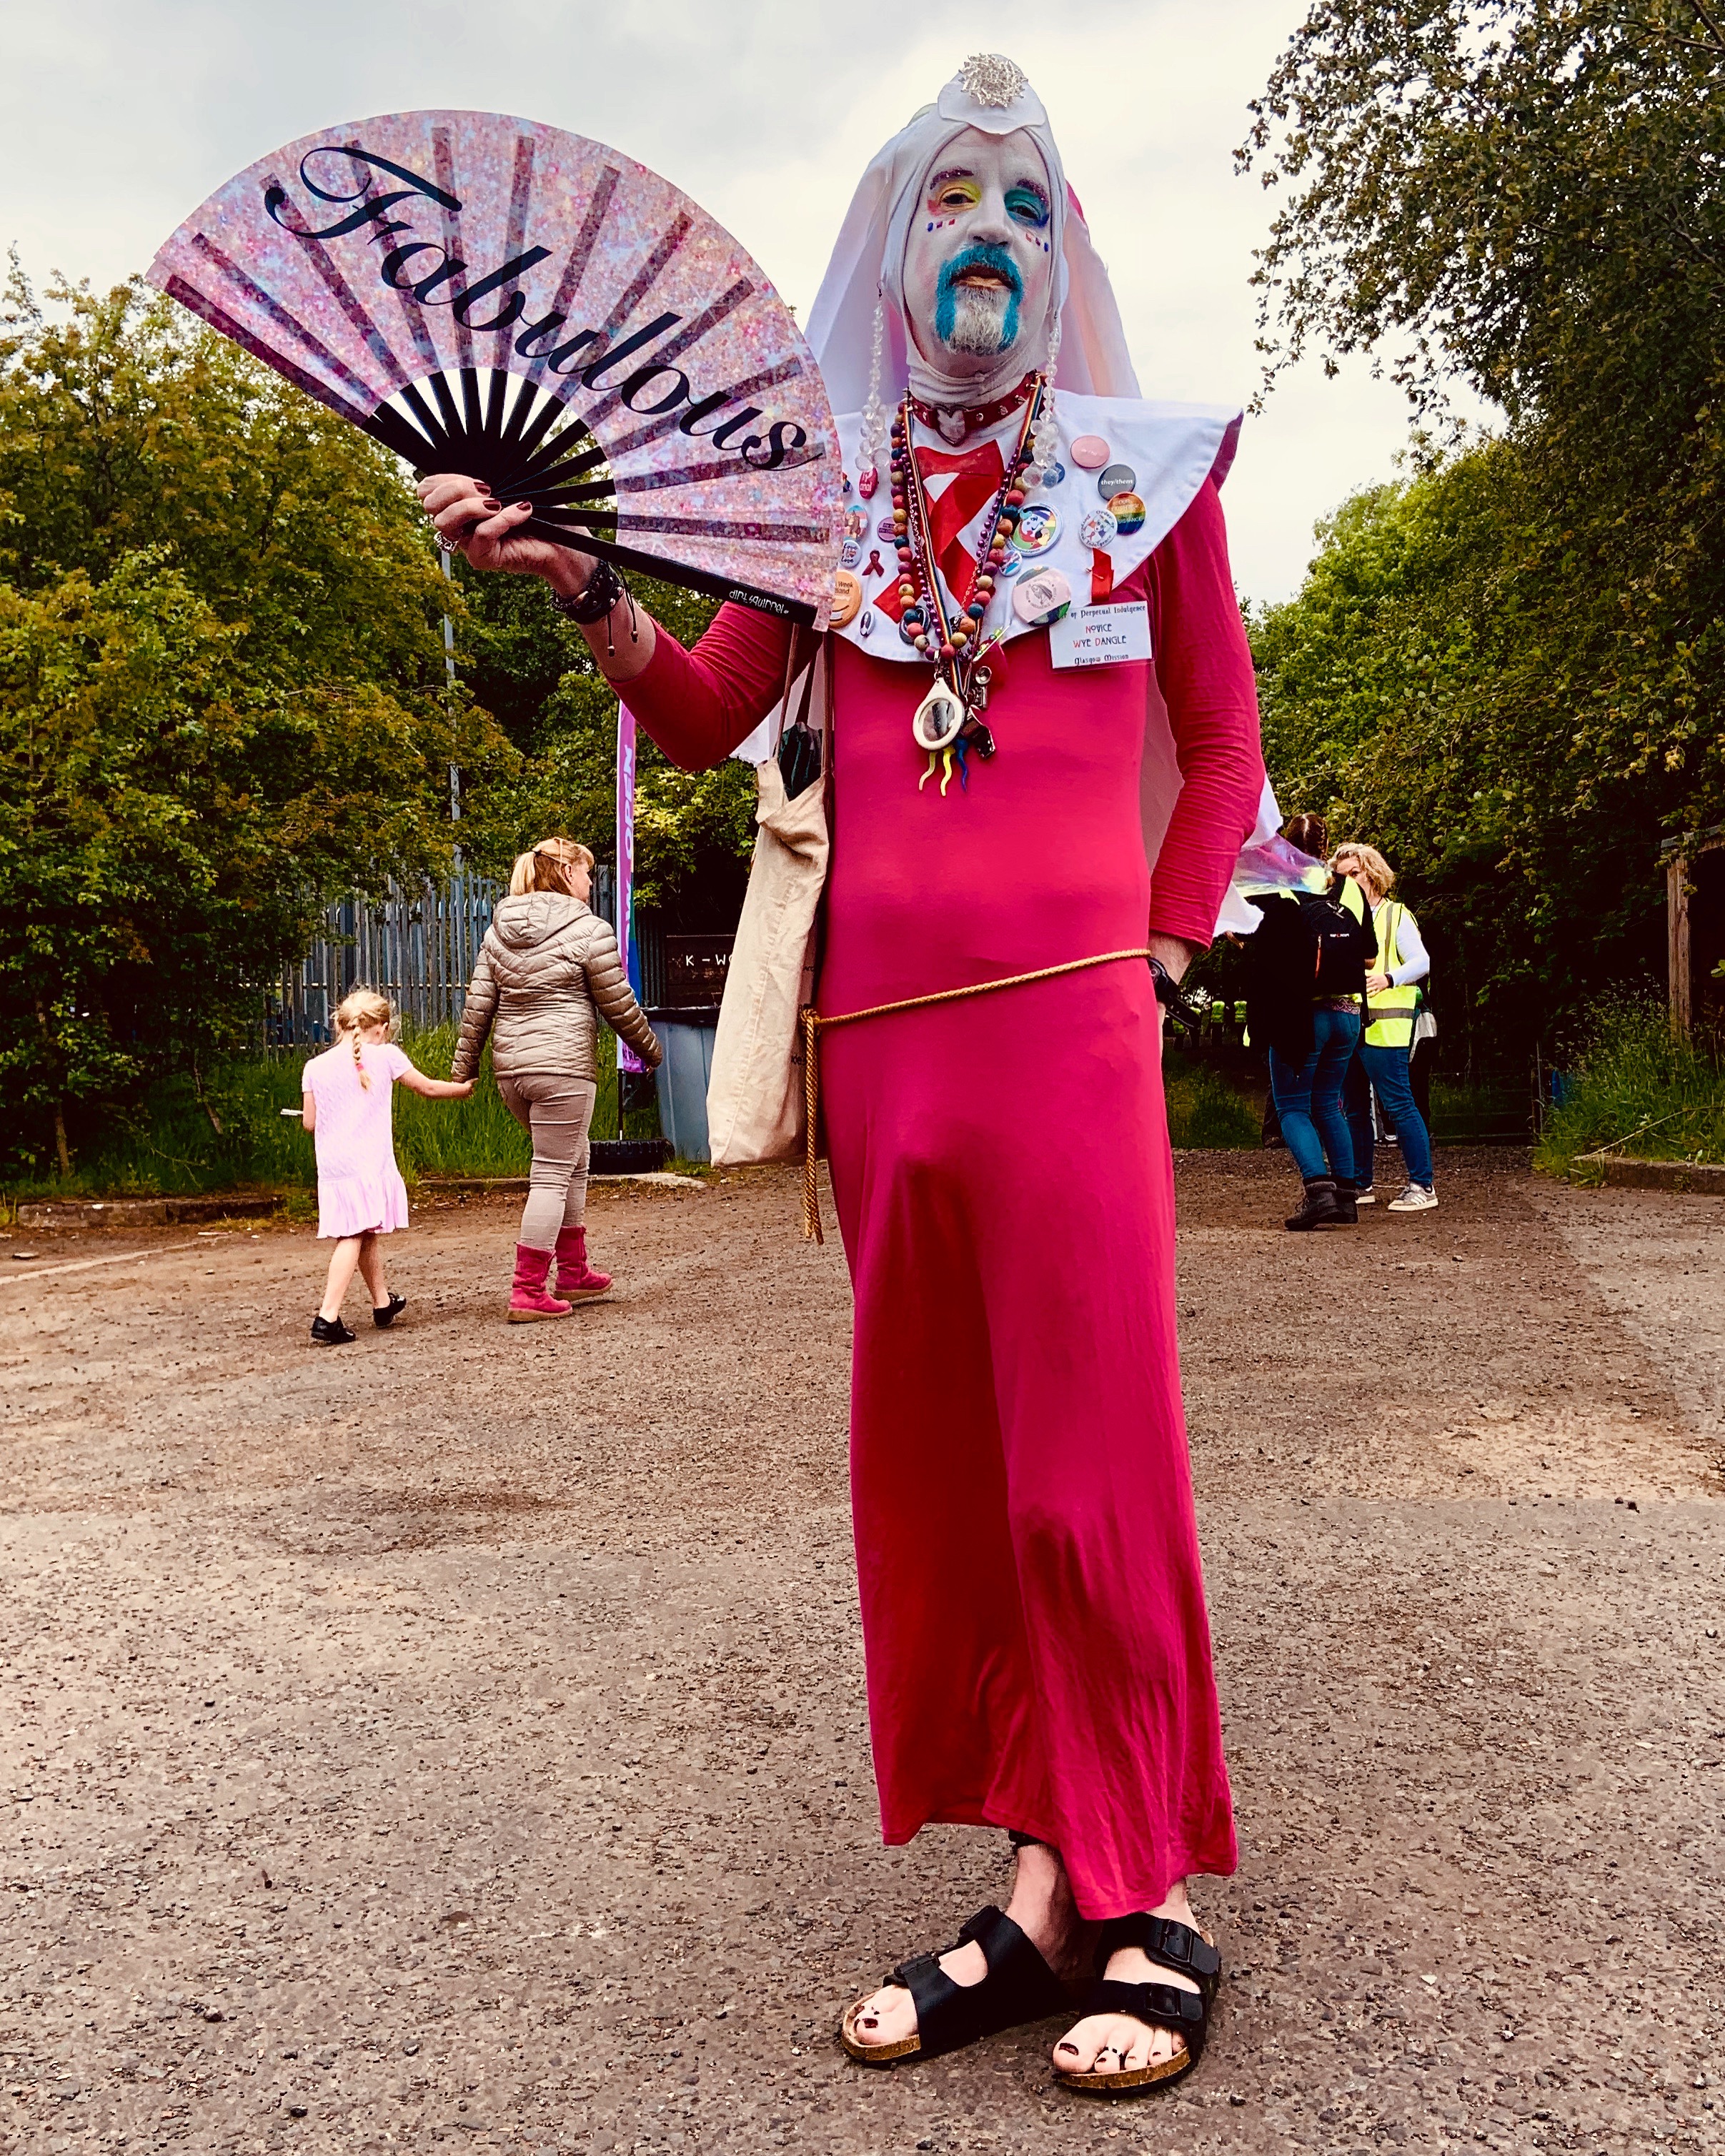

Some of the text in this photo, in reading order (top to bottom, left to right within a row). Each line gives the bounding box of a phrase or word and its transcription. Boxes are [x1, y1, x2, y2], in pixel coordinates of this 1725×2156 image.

[264, 146, 823, 472] Fabulous
[1081, 607, 1111, 618] Perpetual
[1114, 605, 1145, 614] Indulgence
[1095, 635, 1127, 647] DANGLE
[1074, 653, 1129, 667] Glasgow Mission
[623, 744, 632, 860] OPEN
